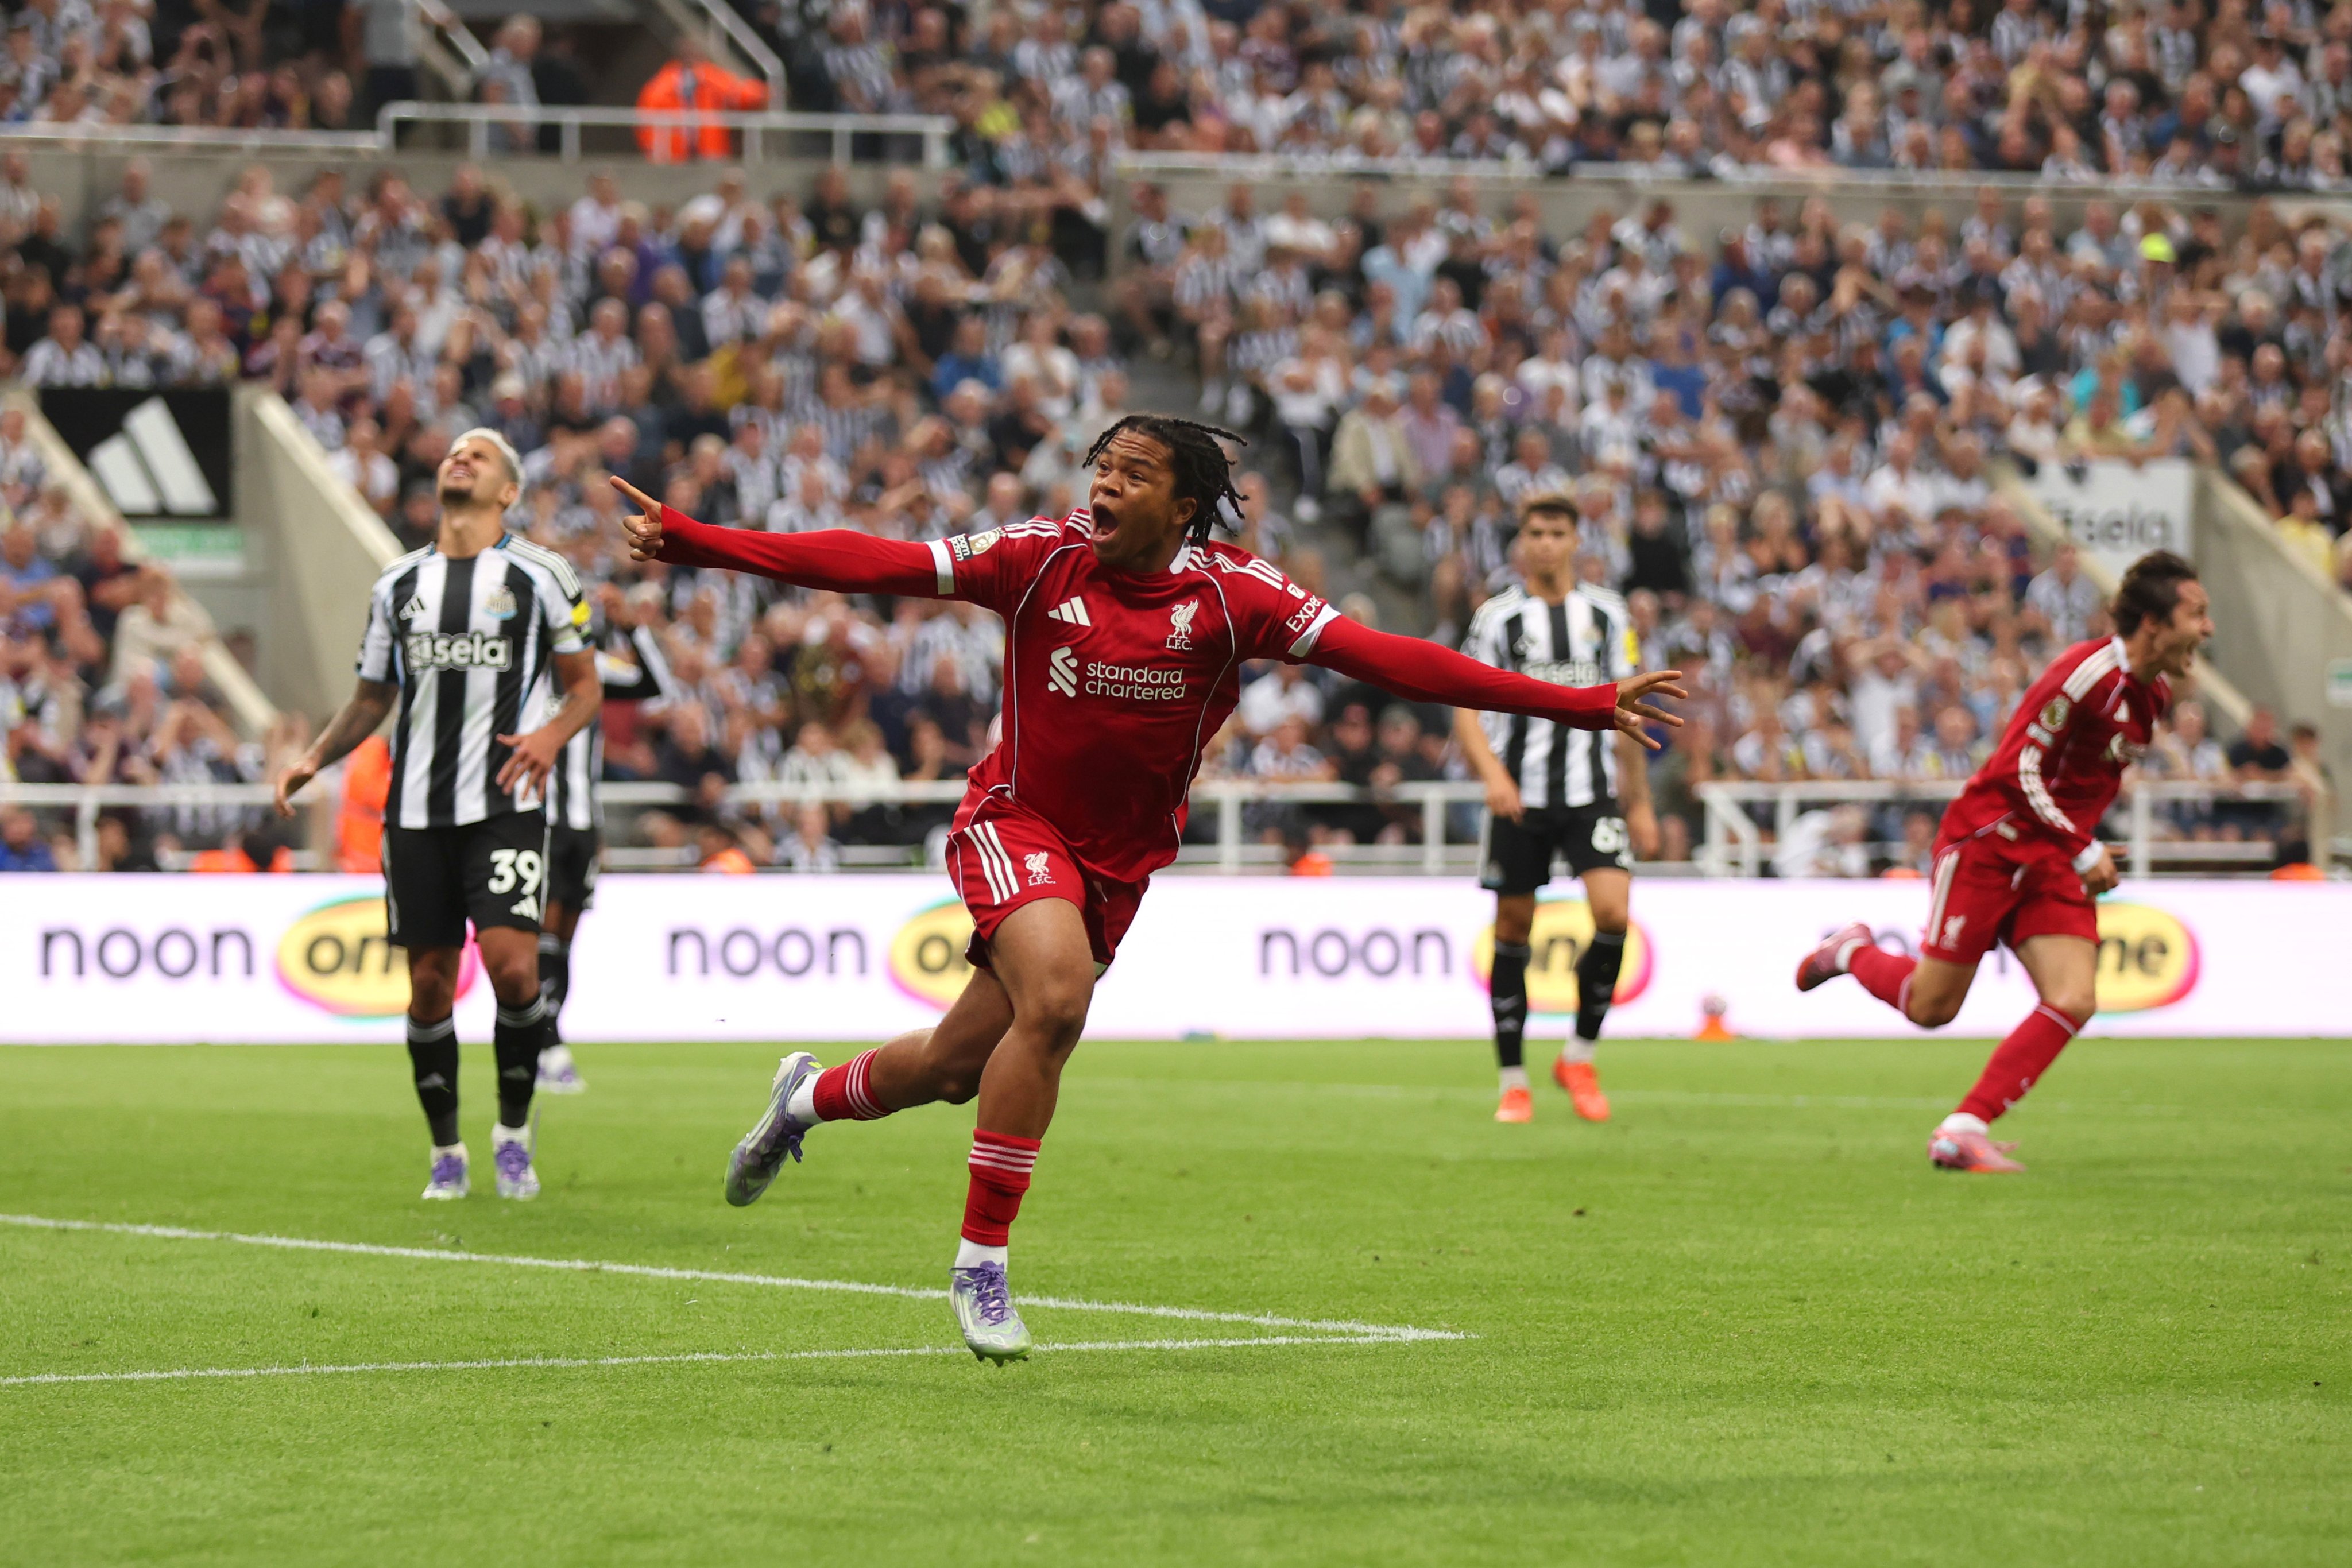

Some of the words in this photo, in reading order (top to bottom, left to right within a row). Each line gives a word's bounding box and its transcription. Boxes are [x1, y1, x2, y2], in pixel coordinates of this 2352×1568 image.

[1165, 637, 1193, 650] L.F.C.
[1085, 679, 1186, 700] chartered
[1086, 661, 1183, 684] standard
[488, 849, 542, 895] 39
[1028, 876, 1056, 886] L.F.C.
[43, 929, 253, 977] noon
[308, 935, 405, 974] on
[670, 928, 866, 976] noon
[1262, 930, 1450, 976] noon
[2098, 935, 2167, 977] ne
